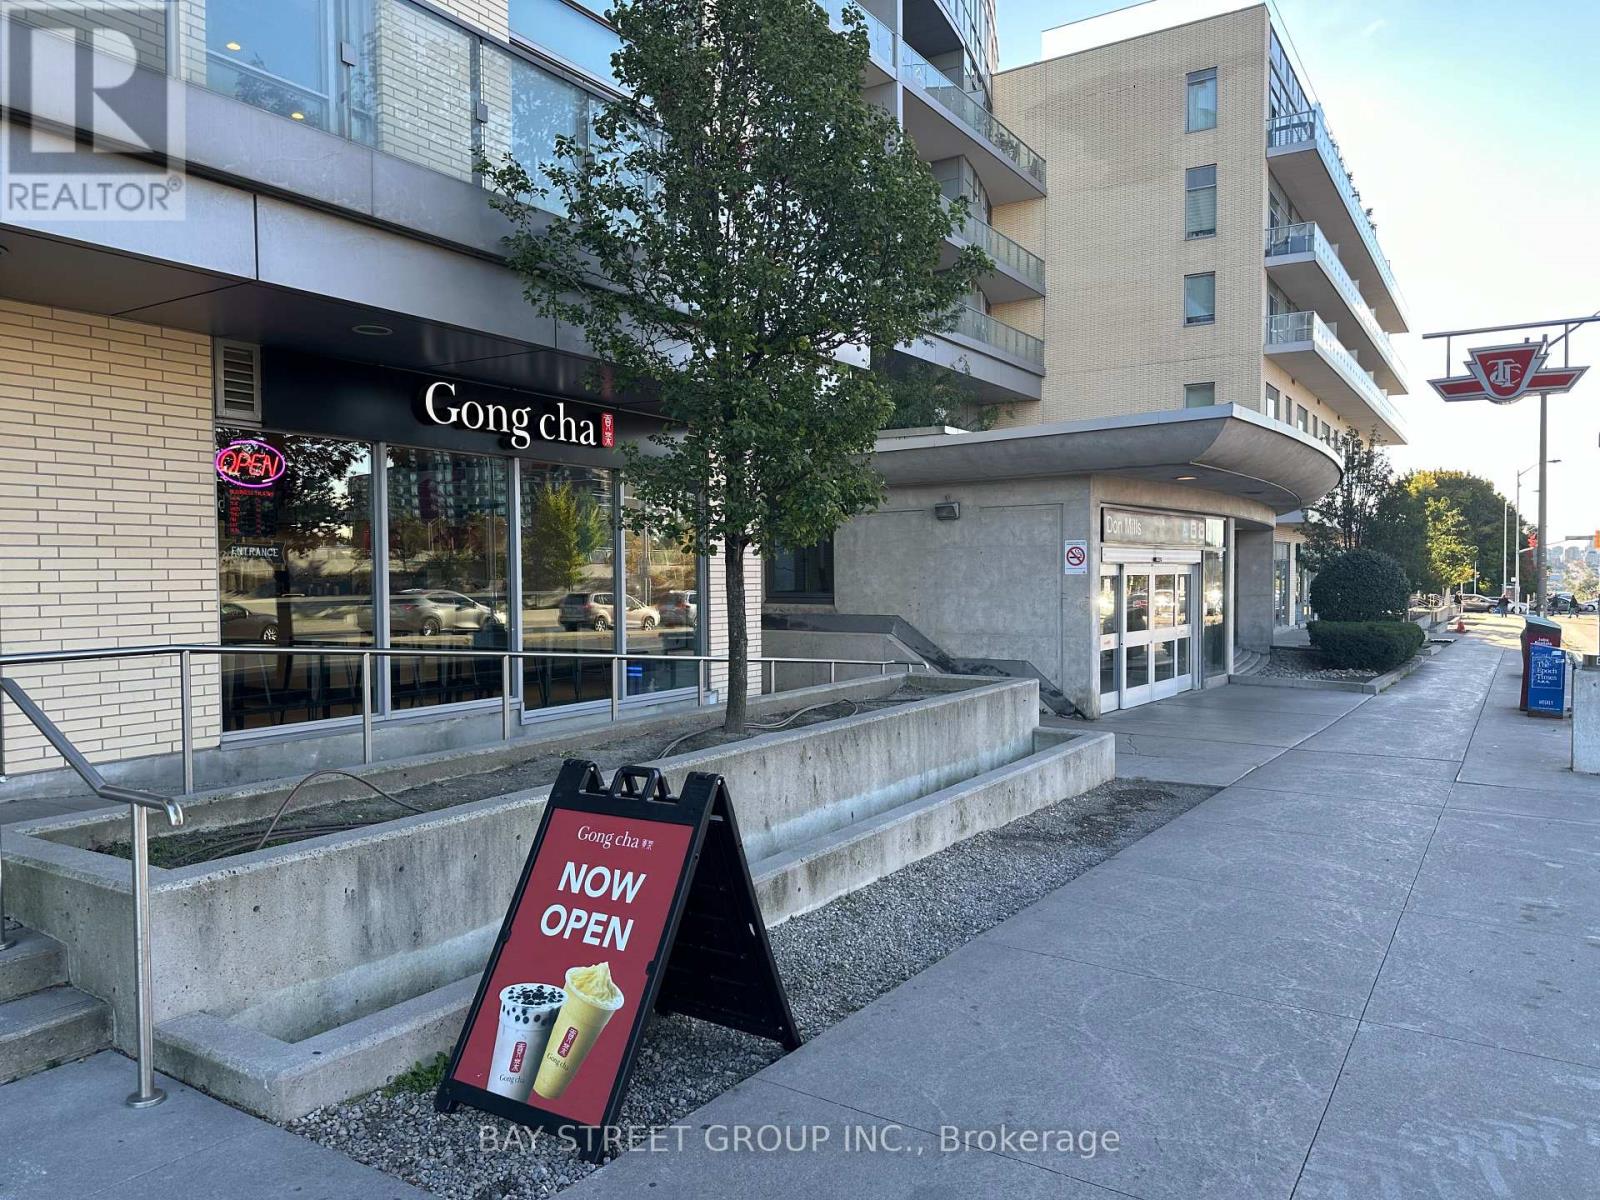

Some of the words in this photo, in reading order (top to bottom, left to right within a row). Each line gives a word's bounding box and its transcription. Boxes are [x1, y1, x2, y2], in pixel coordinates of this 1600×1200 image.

[425, 381, 531, 450] Gong
[539, 402, 597, 446] cha
[220, 450, 279, 478] OPEN
[1106, 515, 1123, 535] Don
[1124, 517, 1142, 536] Mills
[231, 546, 279, 558] ENTRANCE
[1536, 668, 1558, 676] Epoch
[1536, 673, 1558, 681] Times
[577, 825, 615, 849] Gong
[615, 831, 639, 848] cha
[557, 861, 647, 904] NOW
[540, 904, 634, 951] OPEN
